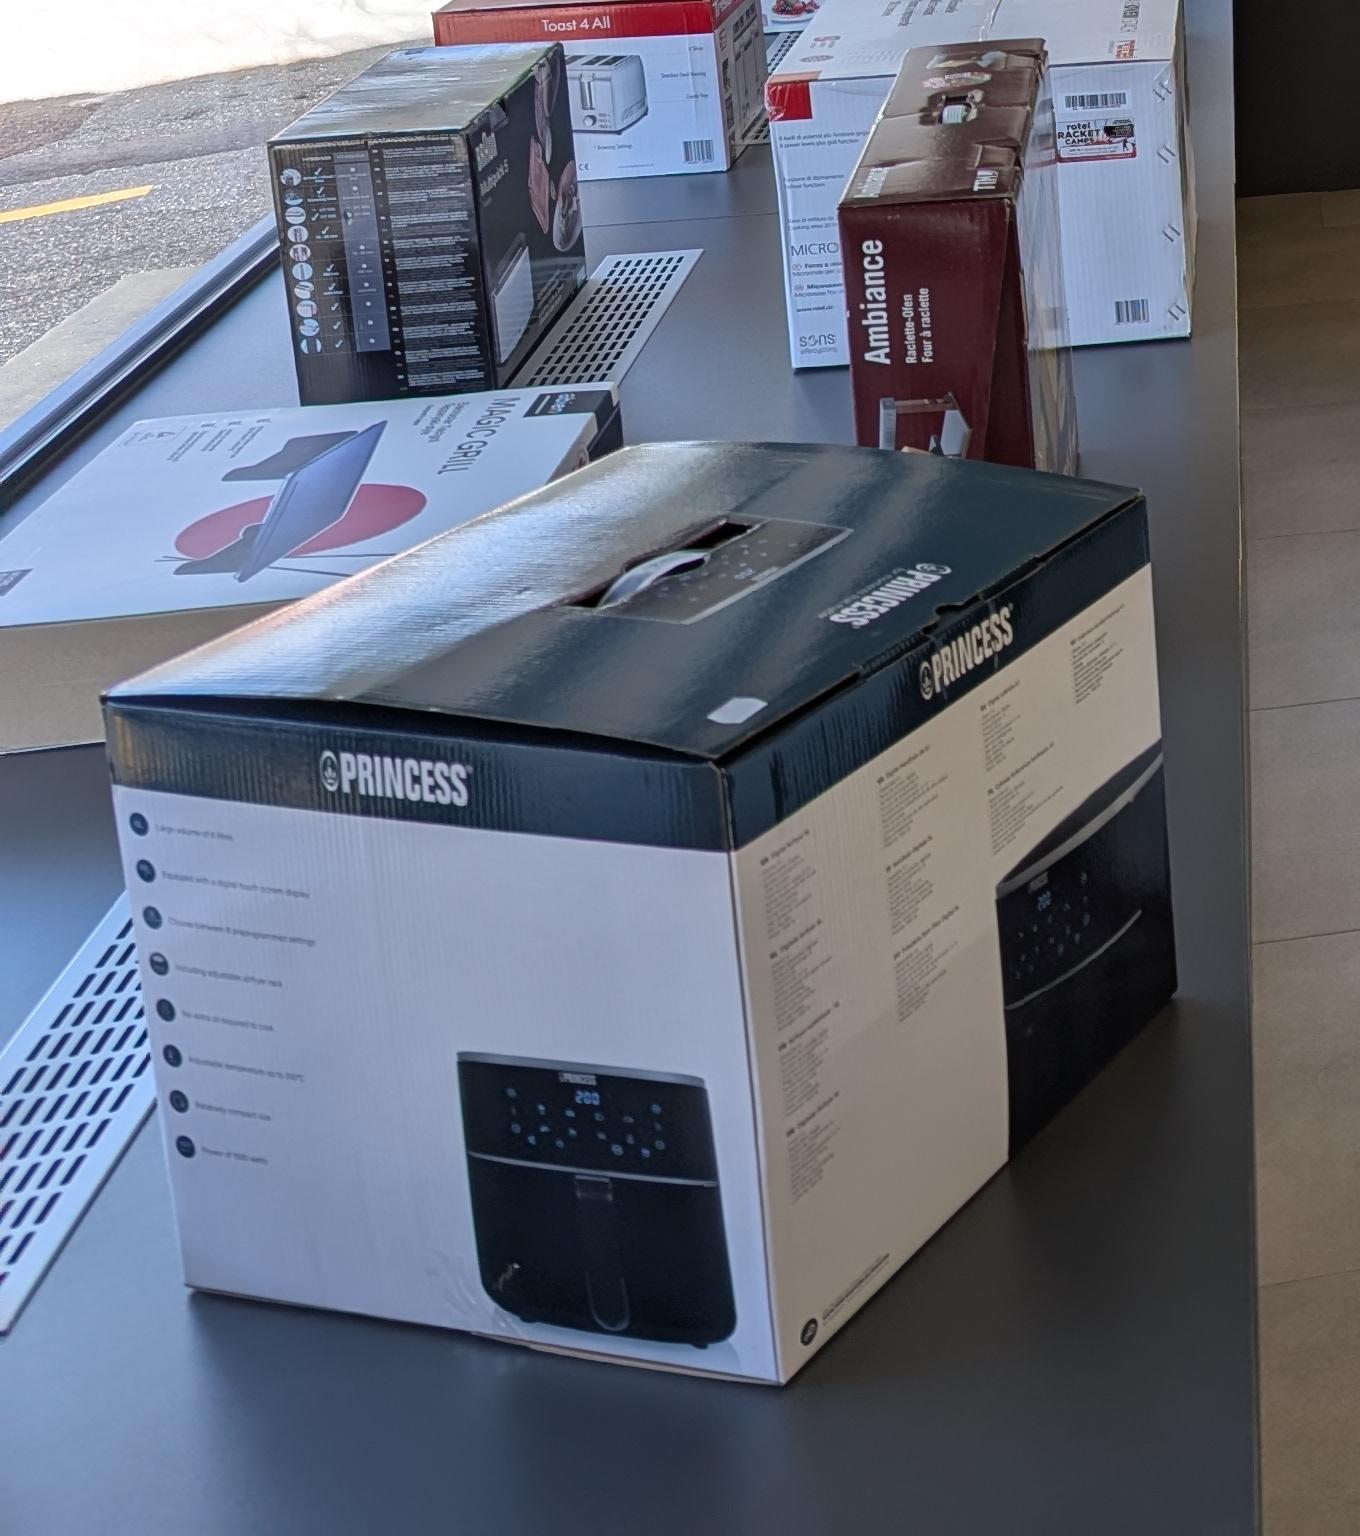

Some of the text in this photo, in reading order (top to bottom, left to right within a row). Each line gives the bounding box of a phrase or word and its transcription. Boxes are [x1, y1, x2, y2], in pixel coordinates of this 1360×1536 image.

[542, 17, 611, 32] Toast 4 All
[1058, 129, 1100, 139] RACKET
[1066, 122, 1091, 131] rotel
[860, 239, 891, 365] Ambiance
[918, 288, 934, 363] Four à raclette
[903, 294, 918, 364] Raclette-Ofen
[466, 397, 520, 439] MAGIC
[437, 440, 489, 475] GRILL
[830, 570, 942, 628] PRINCESS
[931, 606, 1014, 693] PRINCESS
[340, 752, 470, 807] PRINCESS
[575, 1090, 601, 1106] 200
